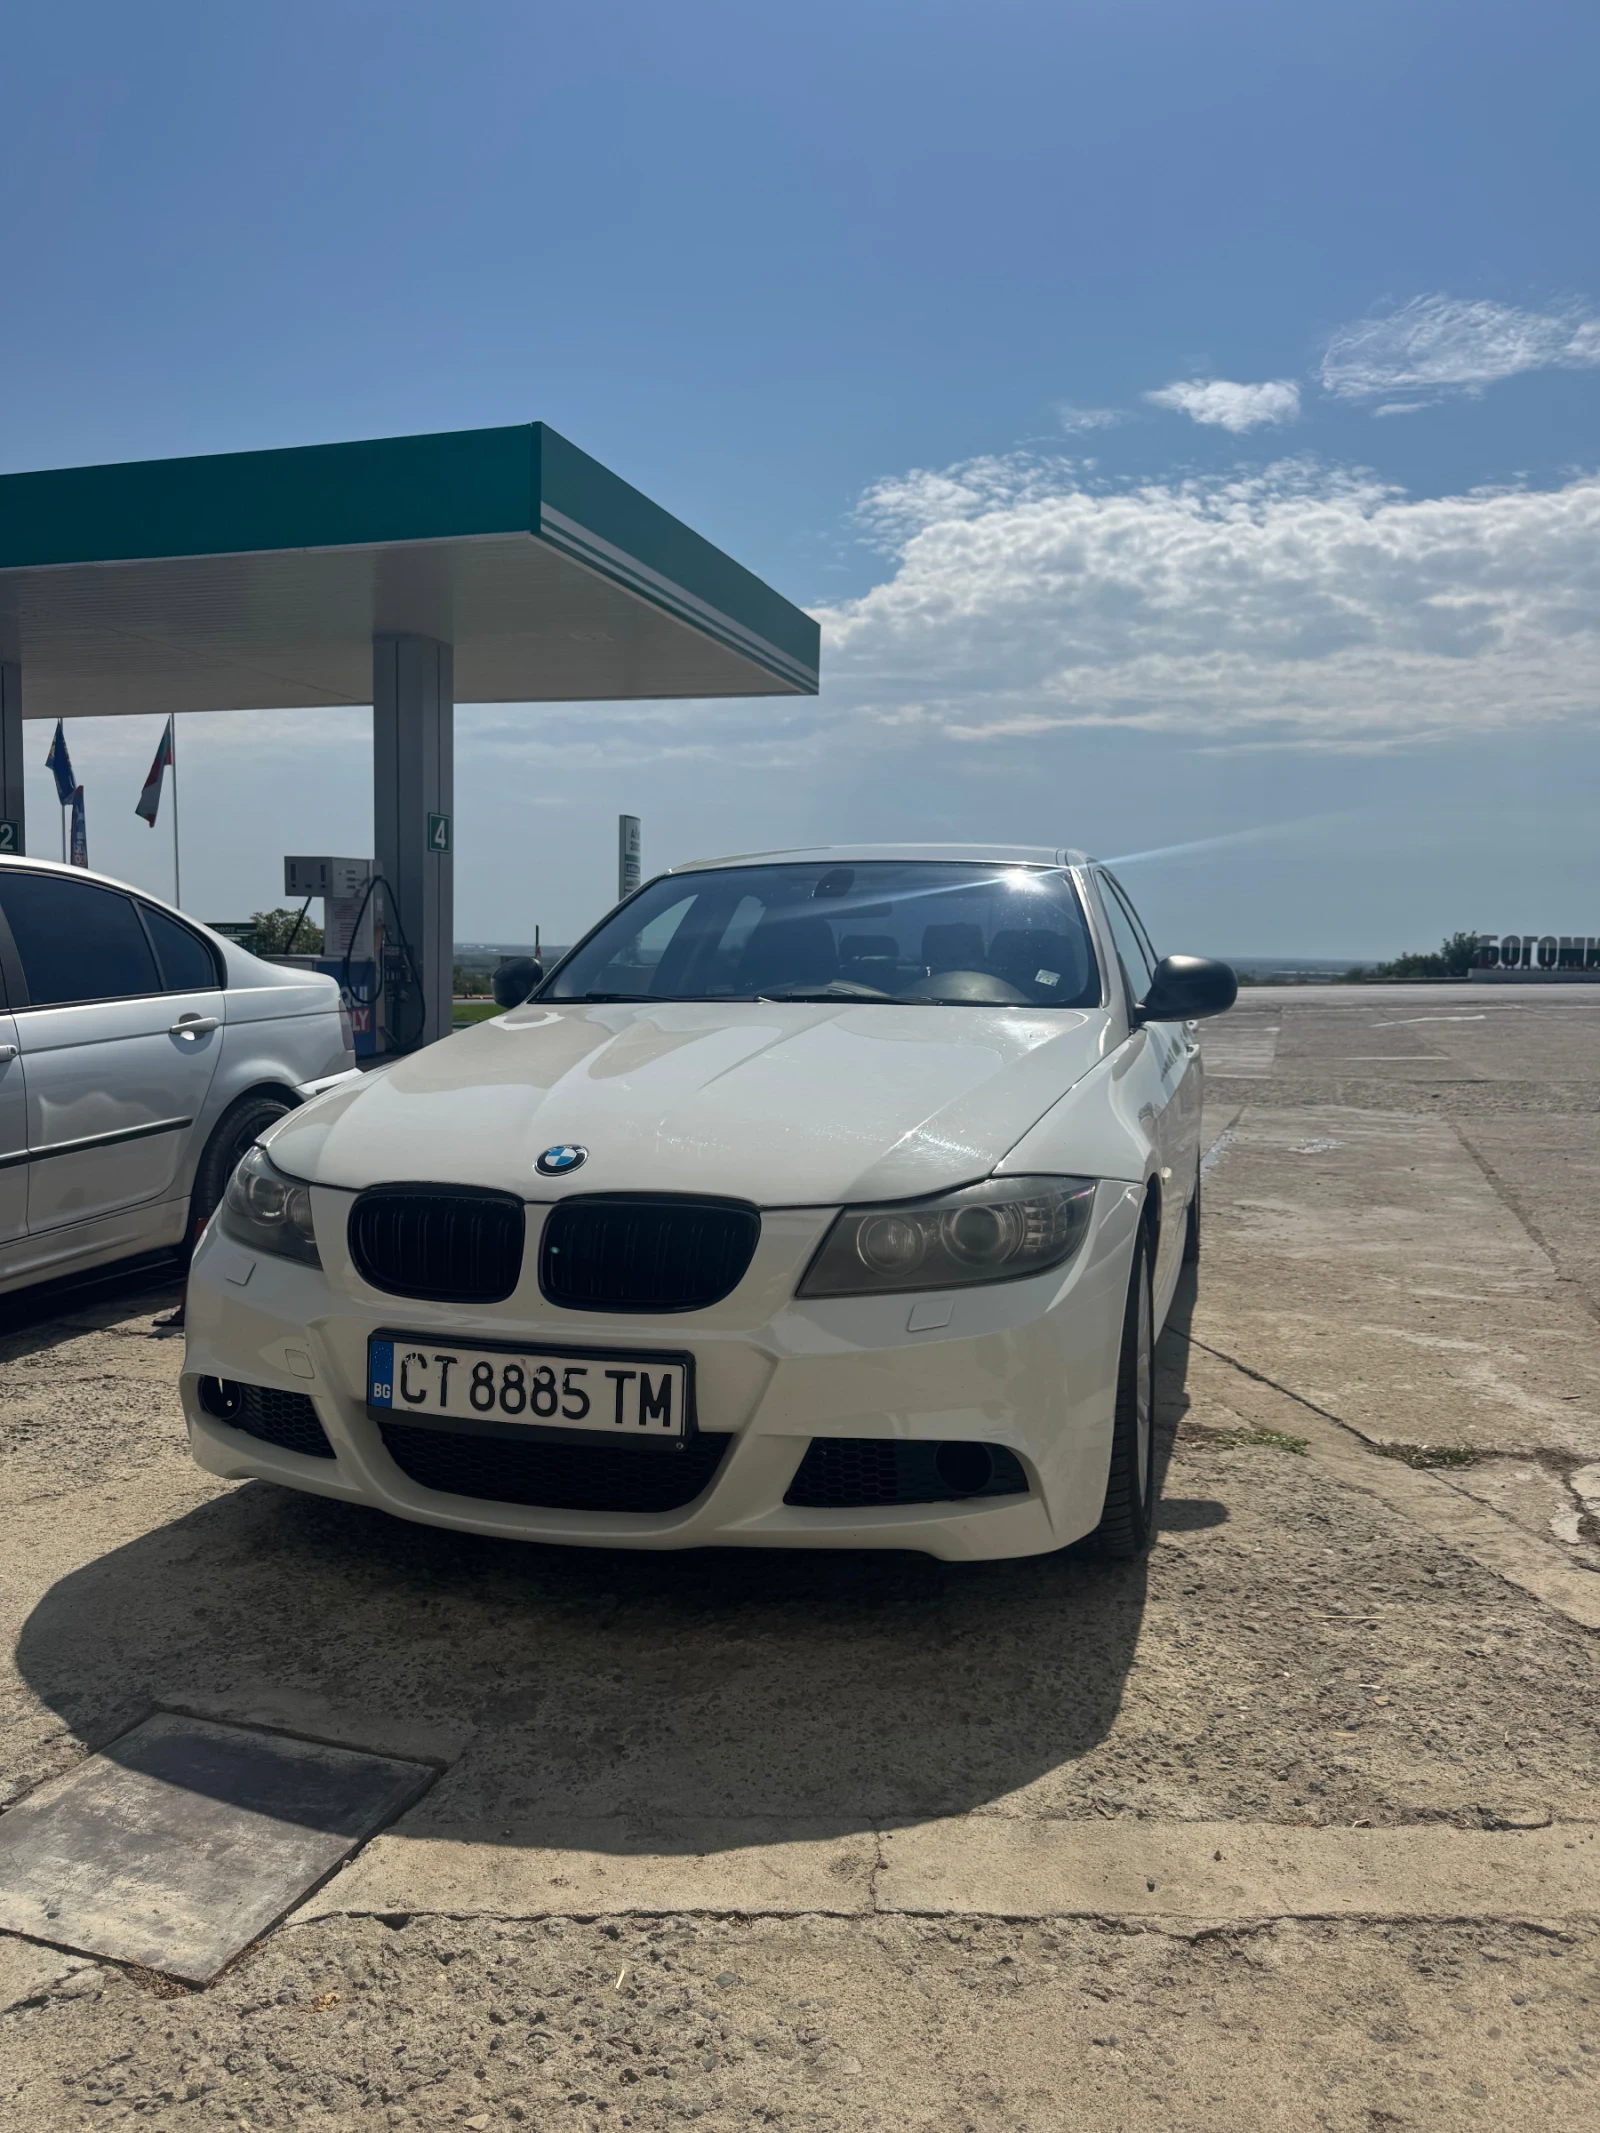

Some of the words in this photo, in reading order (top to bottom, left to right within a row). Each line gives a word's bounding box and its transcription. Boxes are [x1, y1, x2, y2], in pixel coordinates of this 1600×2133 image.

[0, 824, 13, 850] 2
[435, 820, 446, 849] 4
[373, 1383, 391, 1398] BG
[401, 1353, 458, 1407] CT
[470, 1361, 590, 1420] 8885
[605, 1370, 672, 1427] TM
